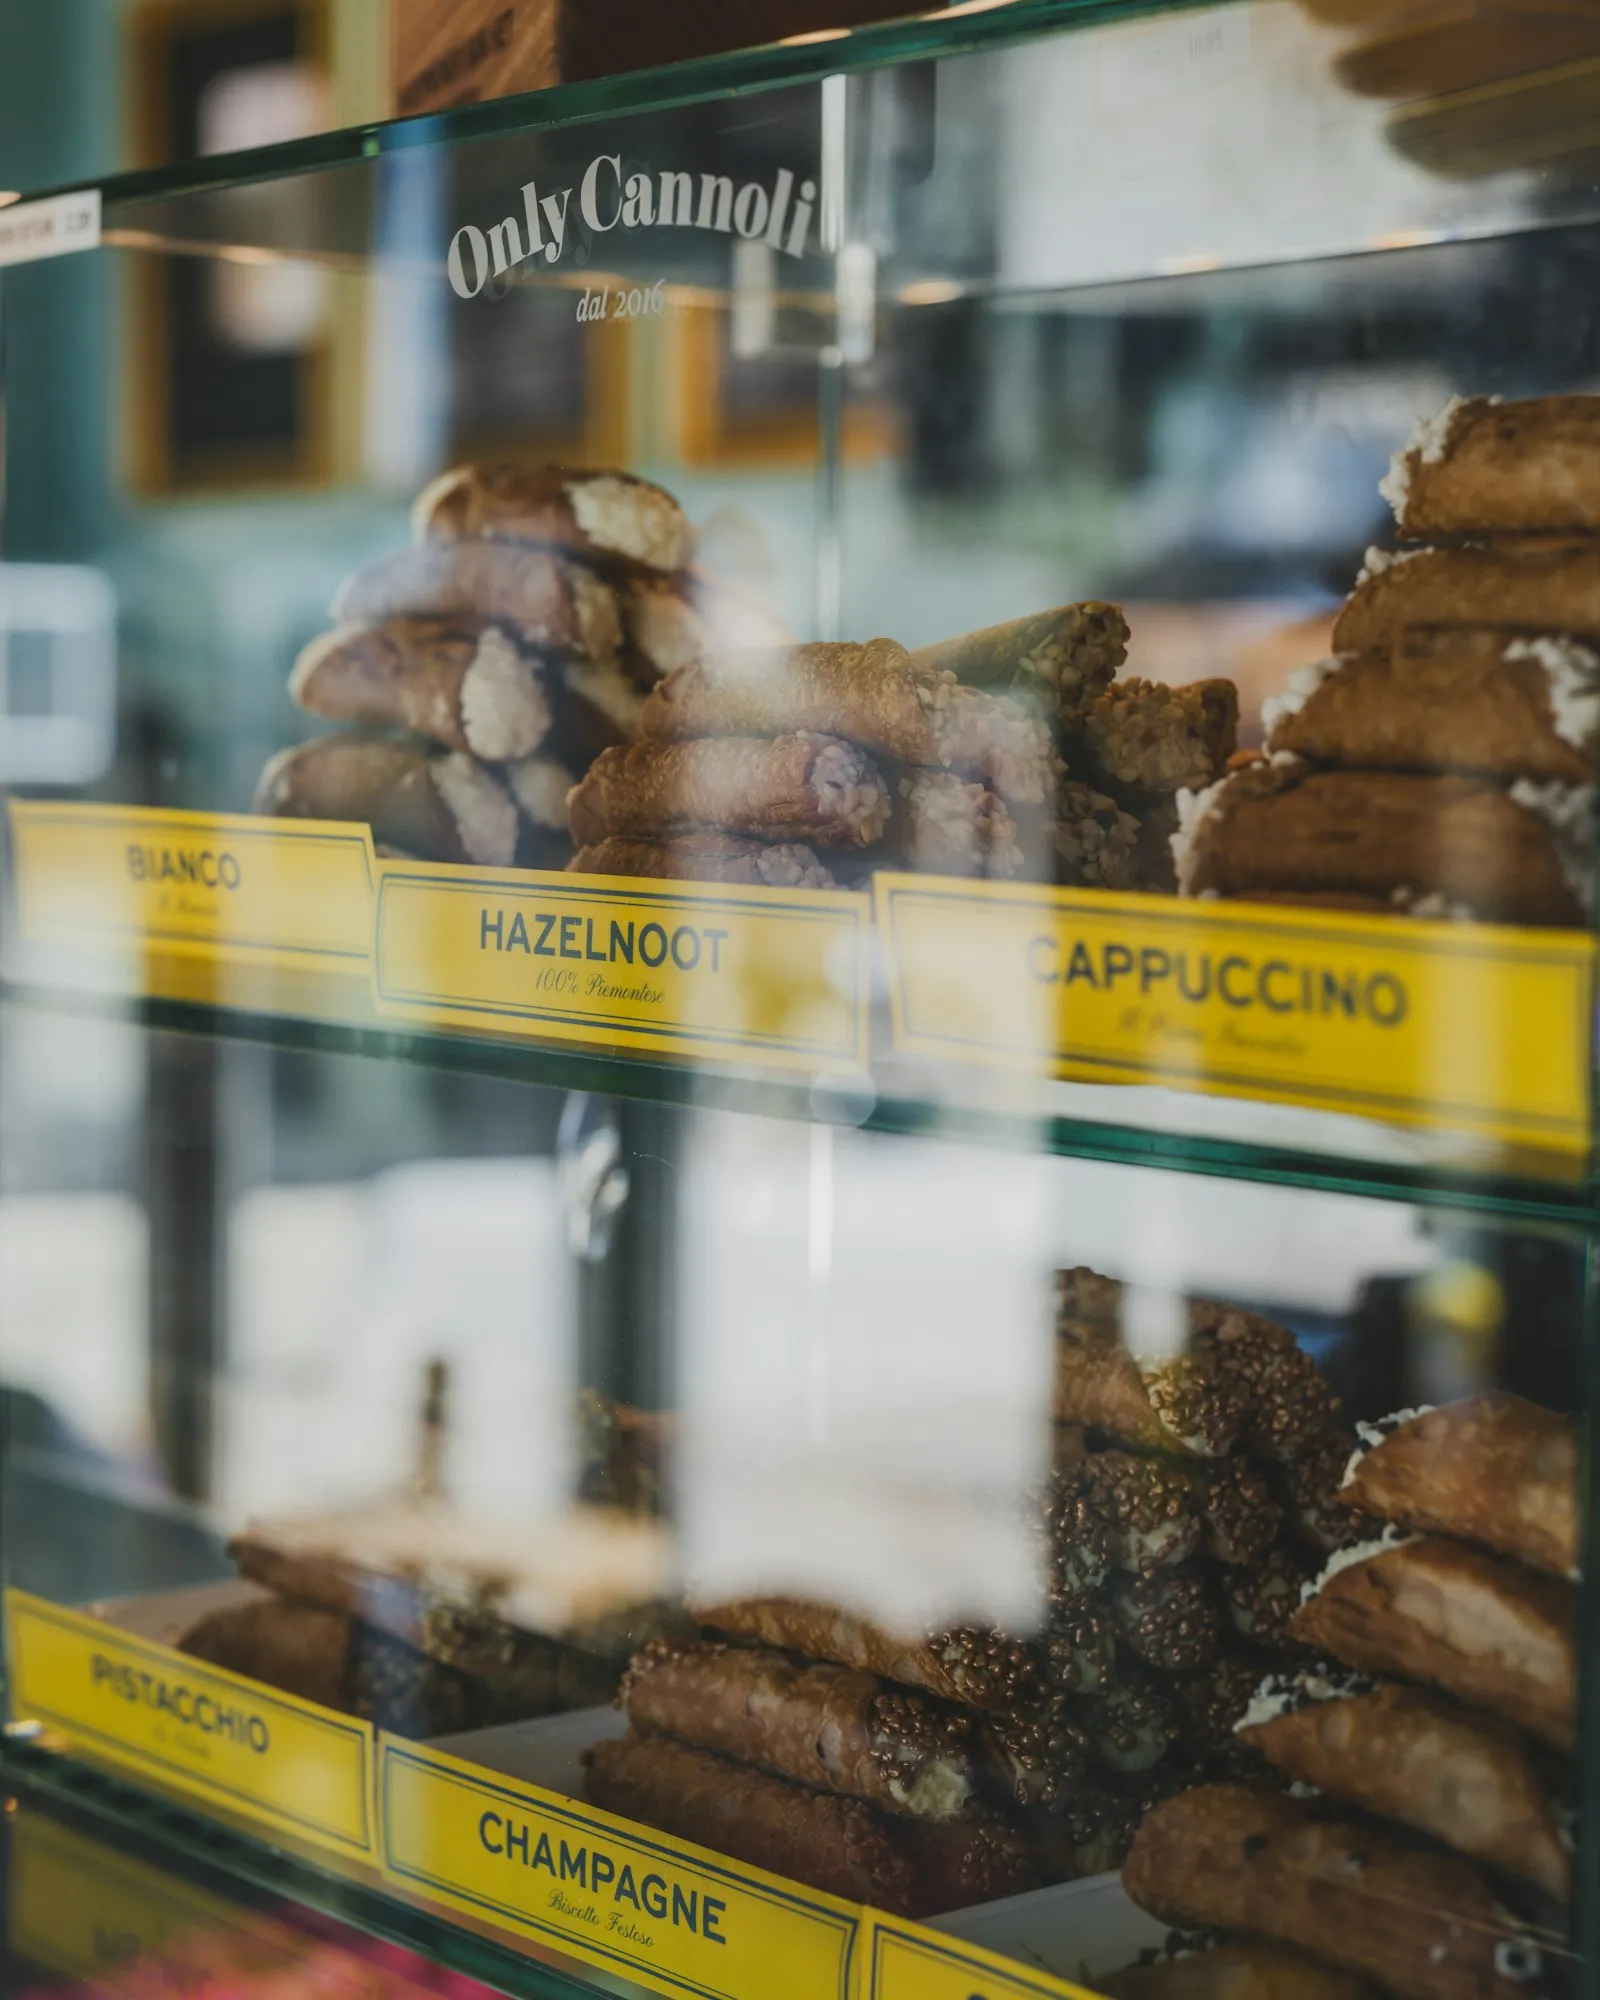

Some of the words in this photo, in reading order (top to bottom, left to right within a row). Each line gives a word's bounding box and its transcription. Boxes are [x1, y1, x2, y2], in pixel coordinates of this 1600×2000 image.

[447, 181, 573, 299] Only
[580, 153, 816, 260] Cannoli
[576, 284, 609, 323] dal
[613, 278, 666, 319] 2016
[126, 844, 241, 891] BIANCO
[480, 908, 729, 973] HAZELNOOT
[535, 966, 579, 995] 100%
[585, 972, 665, 1004] Piemontese
[1027, 935, 1410, 1029] CAPPUCCINO
[90, 1653, 271, 1755] PISTACCHIO
[479, 1811, 727, 1946] CHAMPAGNE
[547, 1887, 600, 1926] Biscotto
[604, 1912, 656, 1948] Festoso
